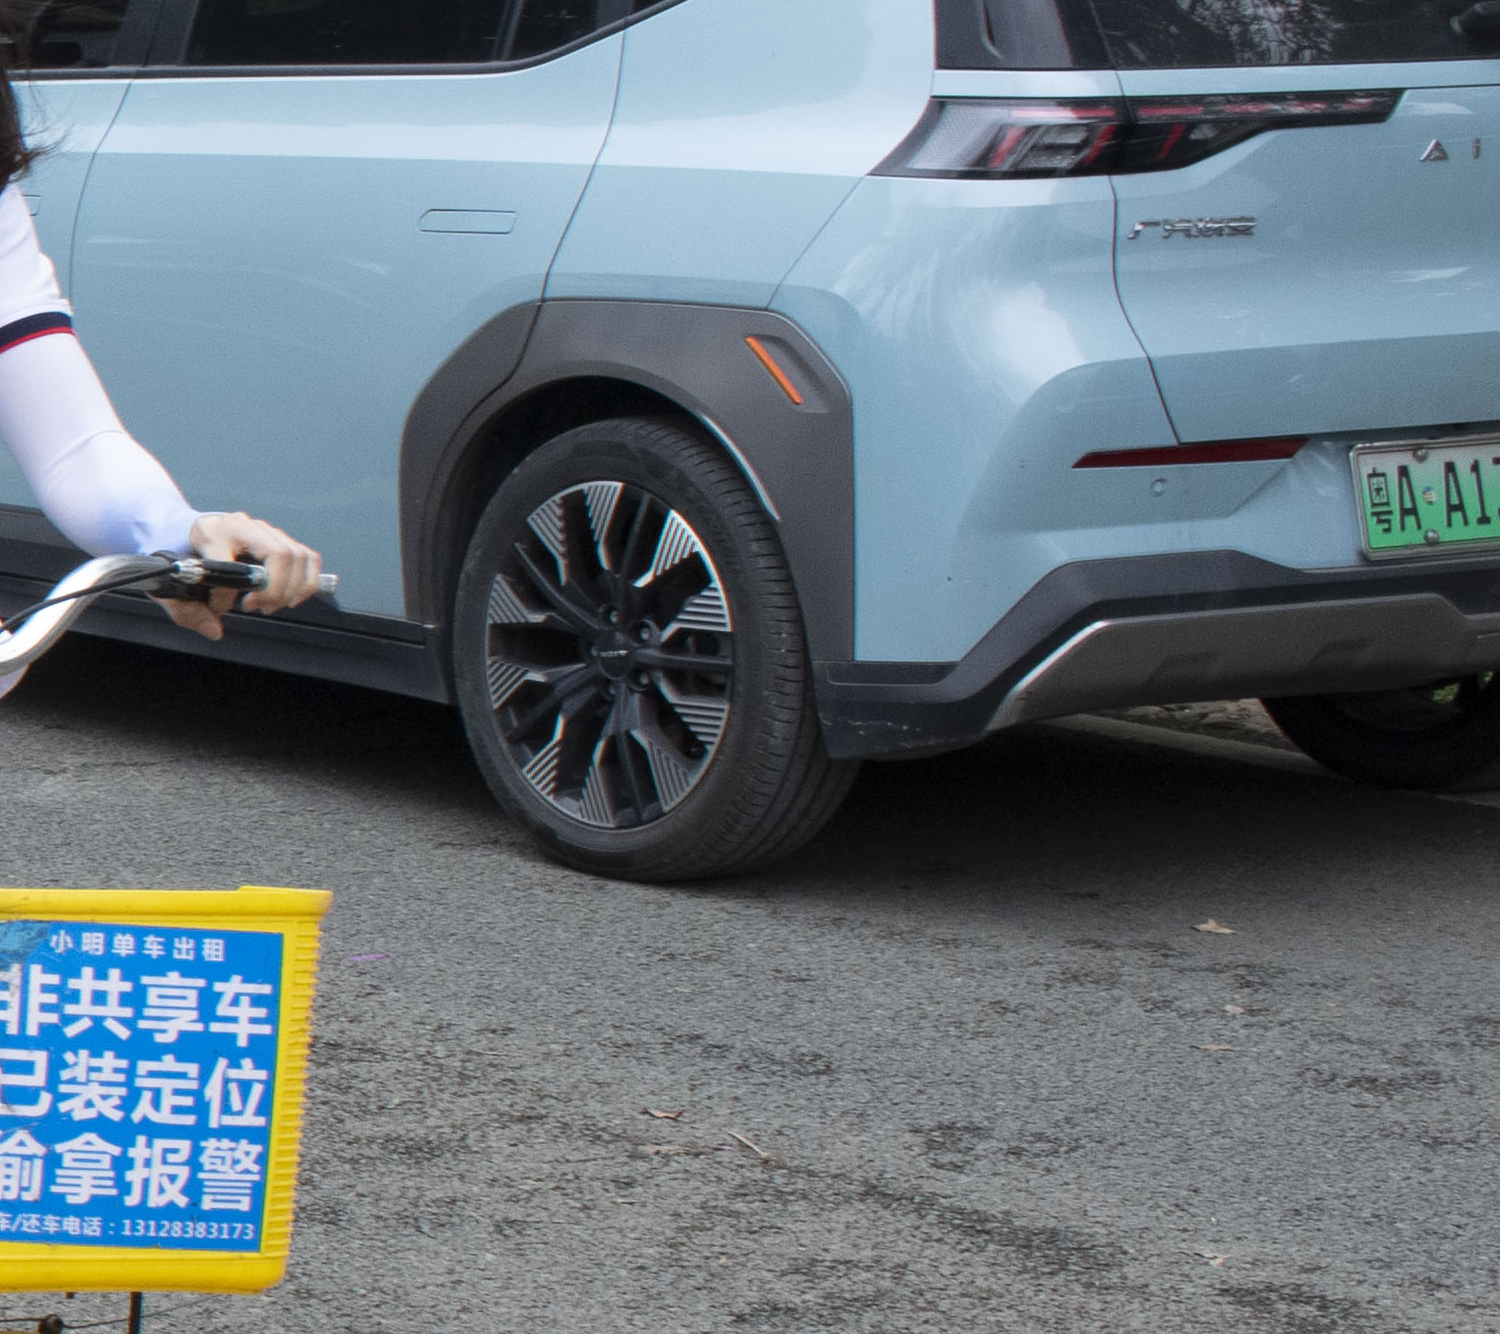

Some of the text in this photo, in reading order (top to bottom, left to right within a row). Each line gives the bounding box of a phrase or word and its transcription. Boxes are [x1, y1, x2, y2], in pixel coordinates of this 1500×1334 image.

[49, 929, 226, 963] 小明单车出租
